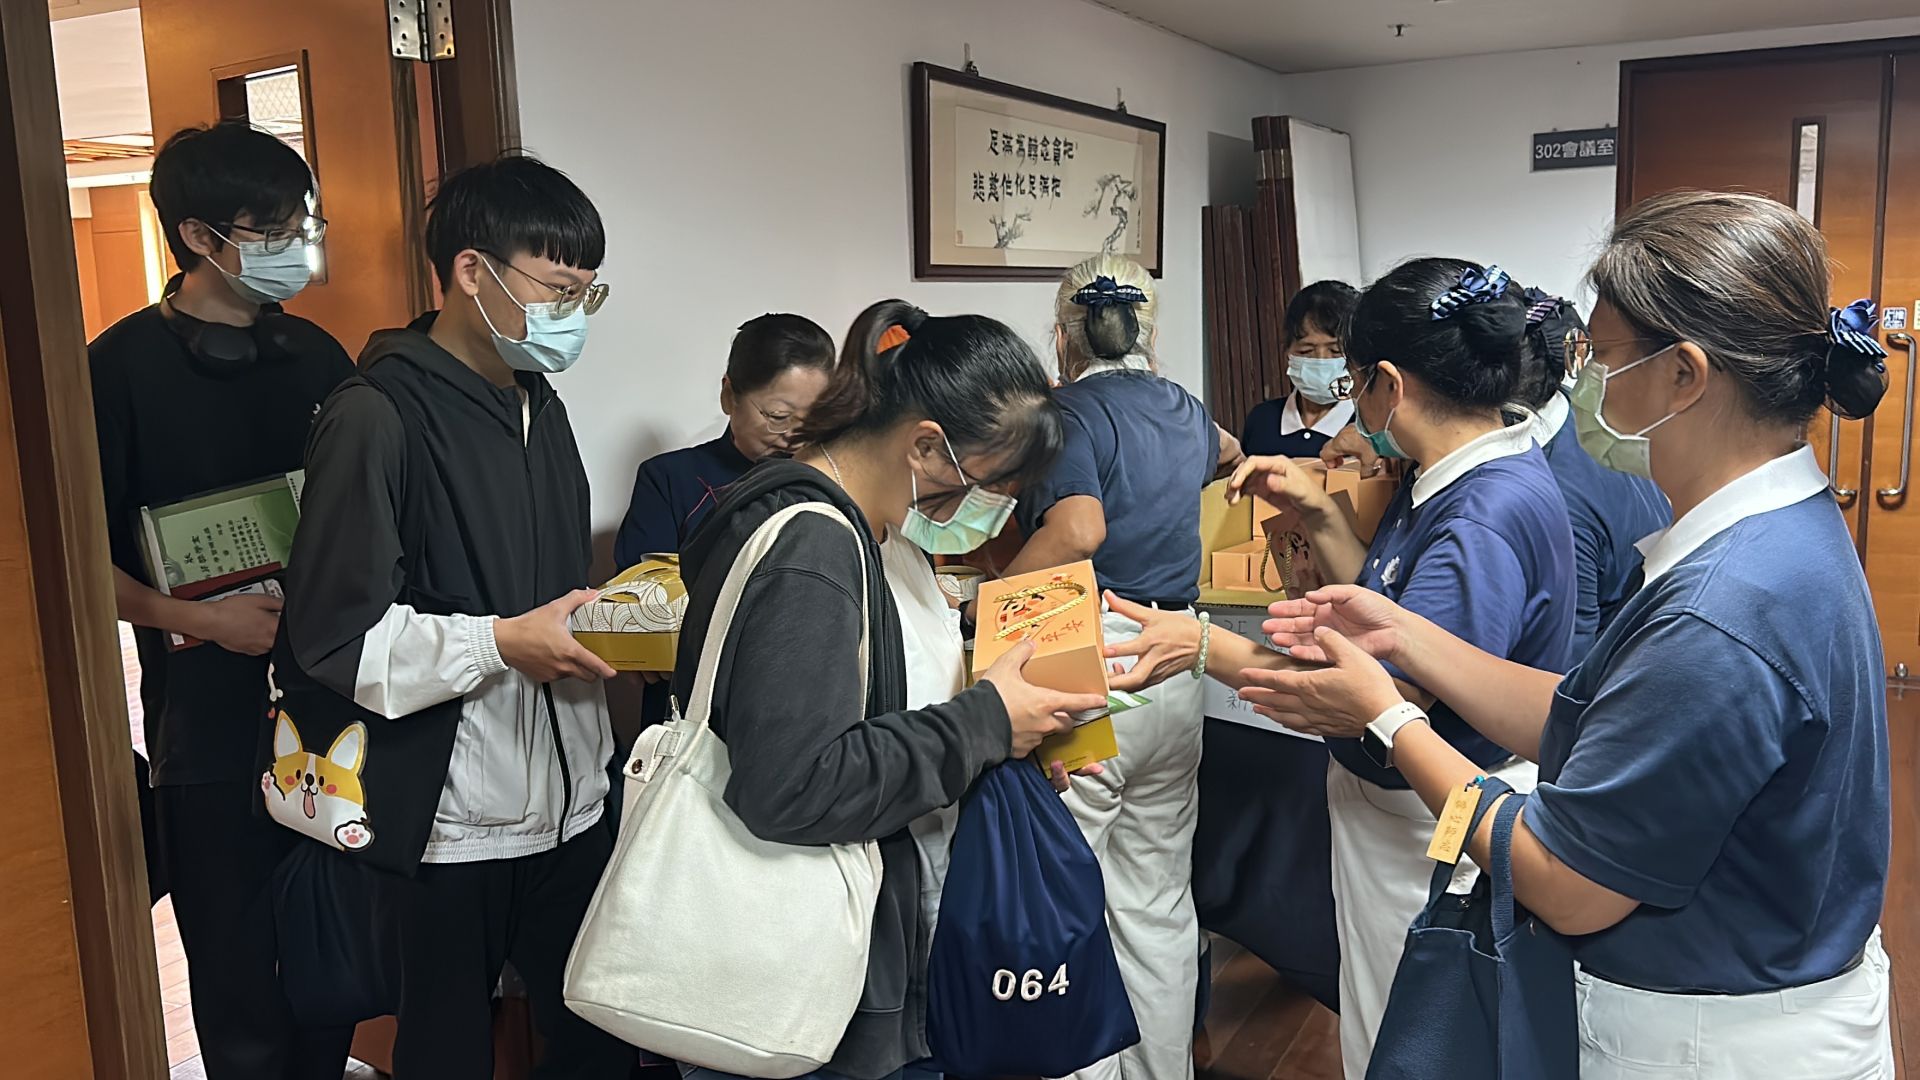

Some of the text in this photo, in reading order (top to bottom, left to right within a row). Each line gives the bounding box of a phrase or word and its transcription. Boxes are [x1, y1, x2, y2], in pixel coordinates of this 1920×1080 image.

[1535, 138, 1614, 159] 302會議室
[992, 963, 1070, 1001] 064
